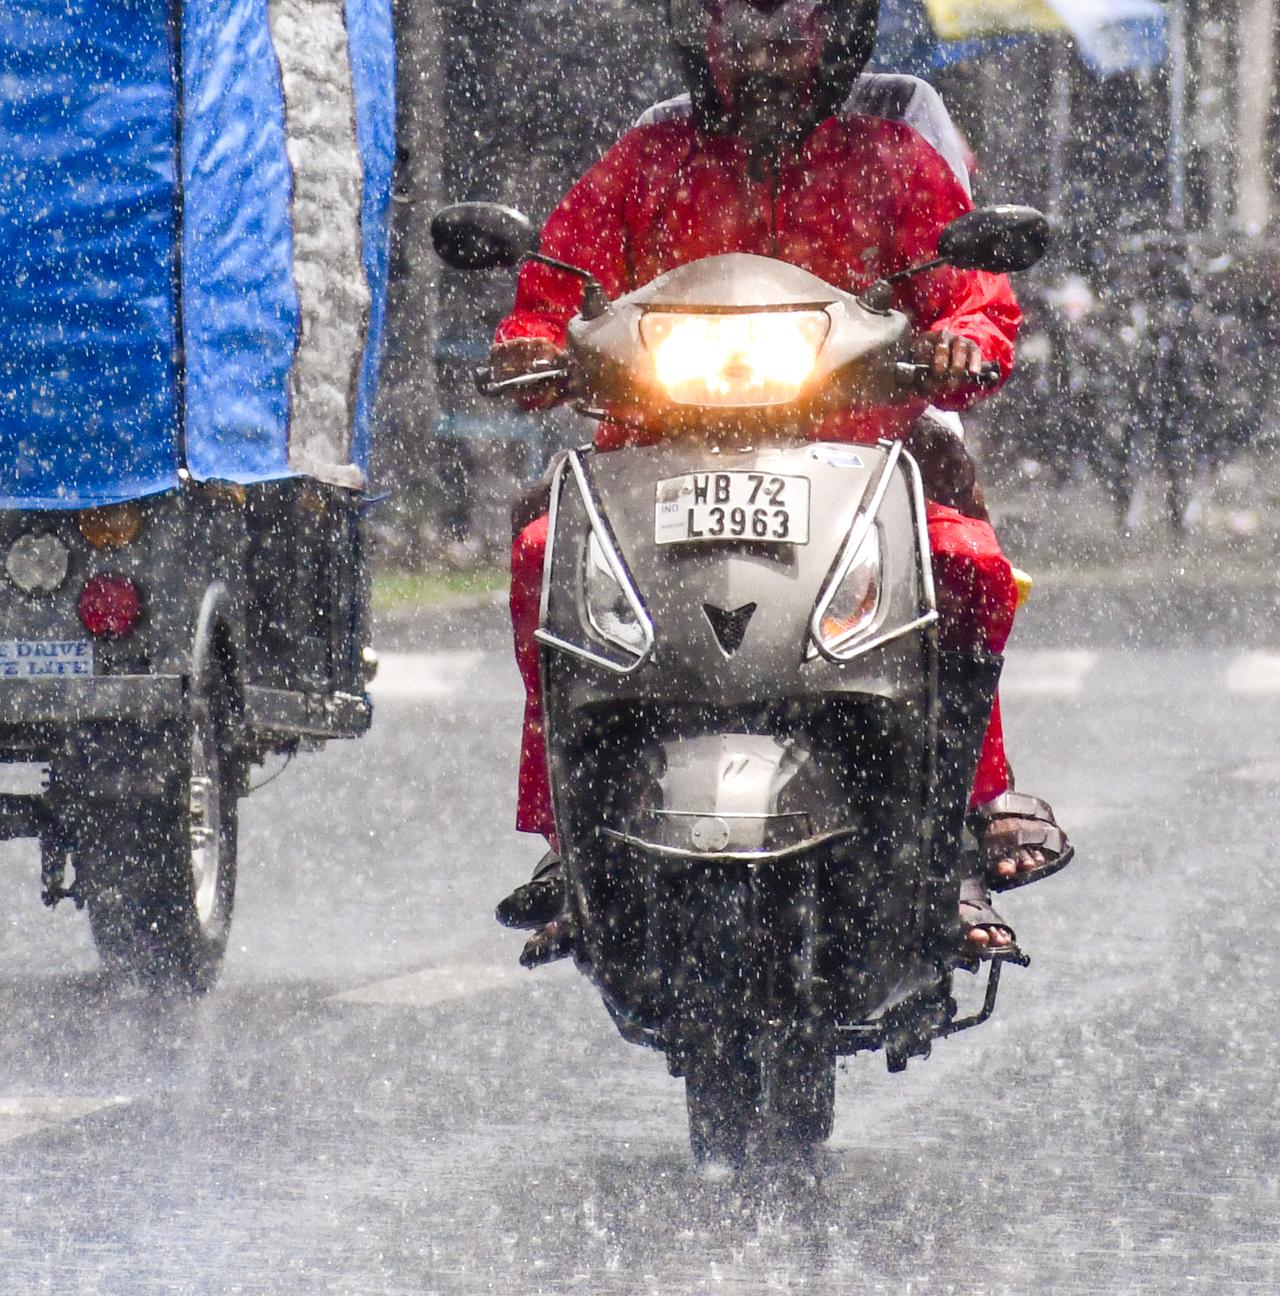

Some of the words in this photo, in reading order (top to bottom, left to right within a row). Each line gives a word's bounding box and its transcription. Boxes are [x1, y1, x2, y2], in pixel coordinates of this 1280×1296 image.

[693, 474, 730, 505] WB
[748, 475, 785, 507] 72
[687, 507, 789, 539] L3963
[16, 643, 88, 657] DRIVE
[28, 662, 88, 675] LIFE
